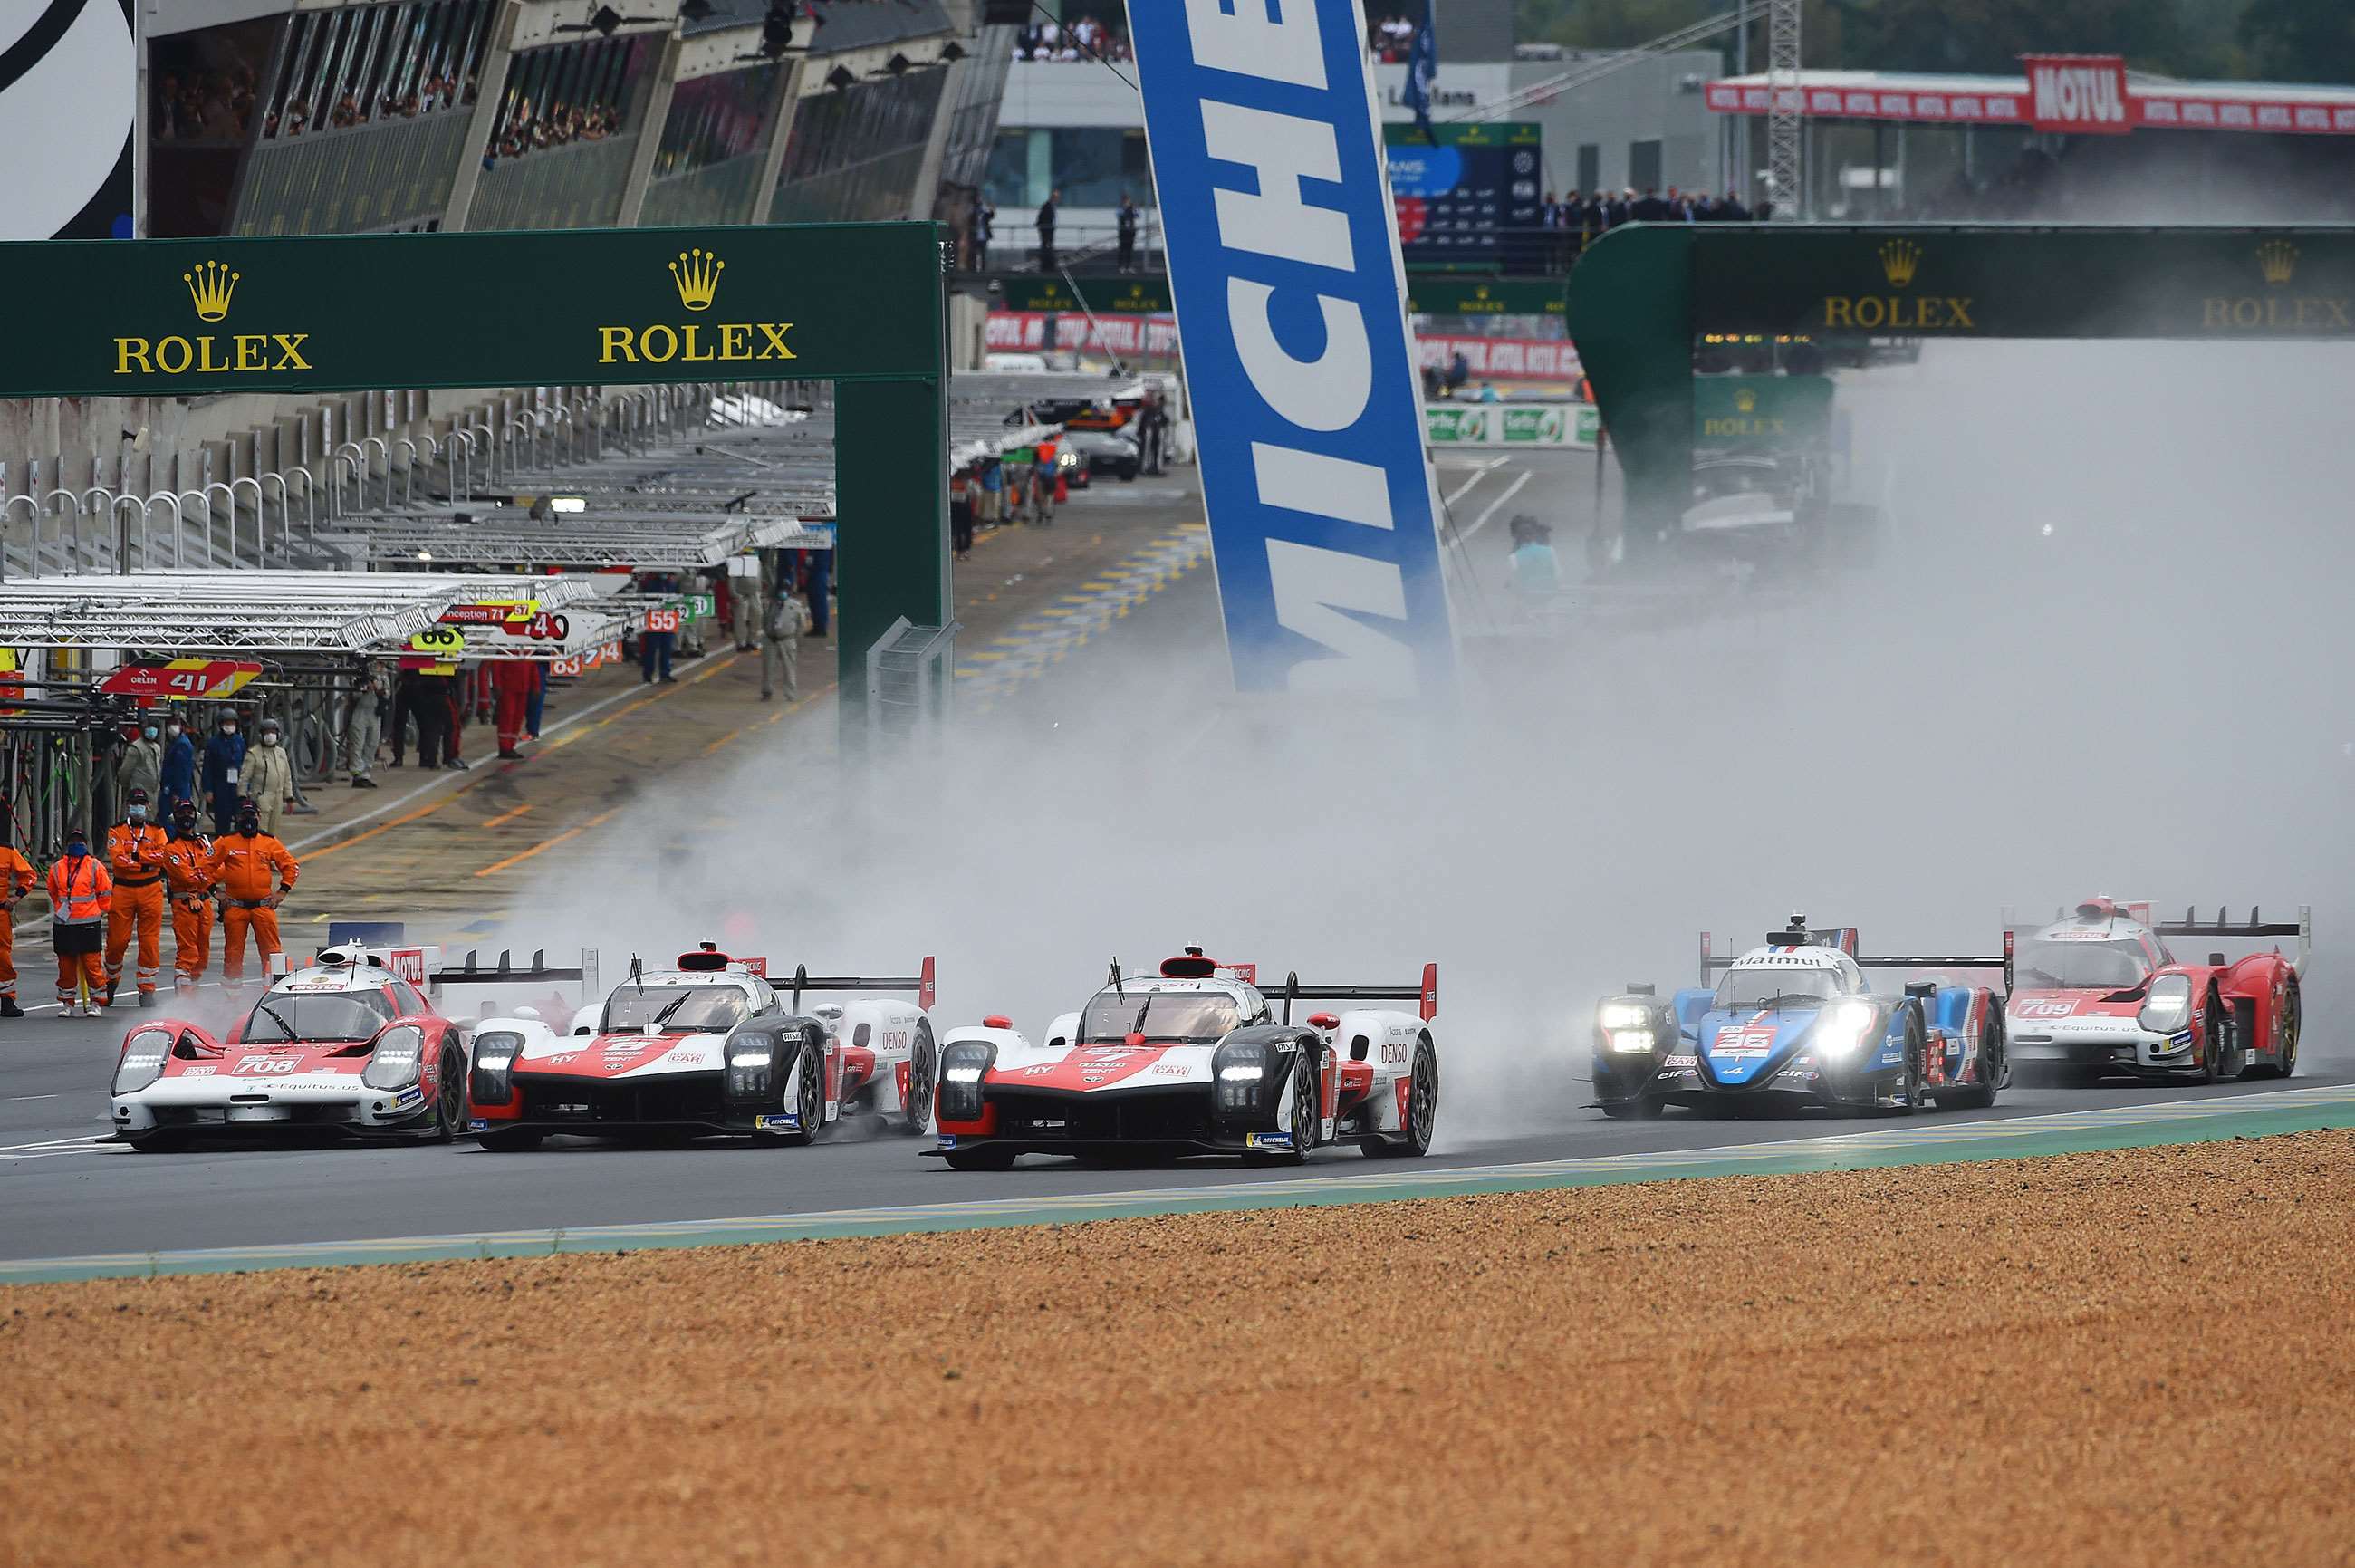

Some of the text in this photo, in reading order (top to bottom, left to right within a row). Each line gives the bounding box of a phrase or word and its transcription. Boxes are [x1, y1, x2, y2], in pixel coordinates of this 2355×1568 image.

[2034, 67, 2124, 122] MOTUL
[1824, 296, 1975, 329] ROLEX
[2201, 296, 2352, 329] ROLEX
[597, 322, 798, 364] ROLEX
[114, 333, 312, 374] ROLEX
[1705, 418, 1784, 437] ROLEX
[491, 609, 505, 620] 71
[514, 604, 529, 616] 57
[650, 611, 676, 630] 55
[170, 673, 208, 692] 41
[1737, 956, 1822, 967] Matmut
[2023, 1003, 2072, 1015] 709
[882, 1031, 908, 1050] DENSO
[1380, 1043, 1408, 1064] DENSO
[237, 1060, 296, 1073] 708
[1658, 1071, 1684, 1081] elf
[1776, 1070, 1803, 1080] elf
